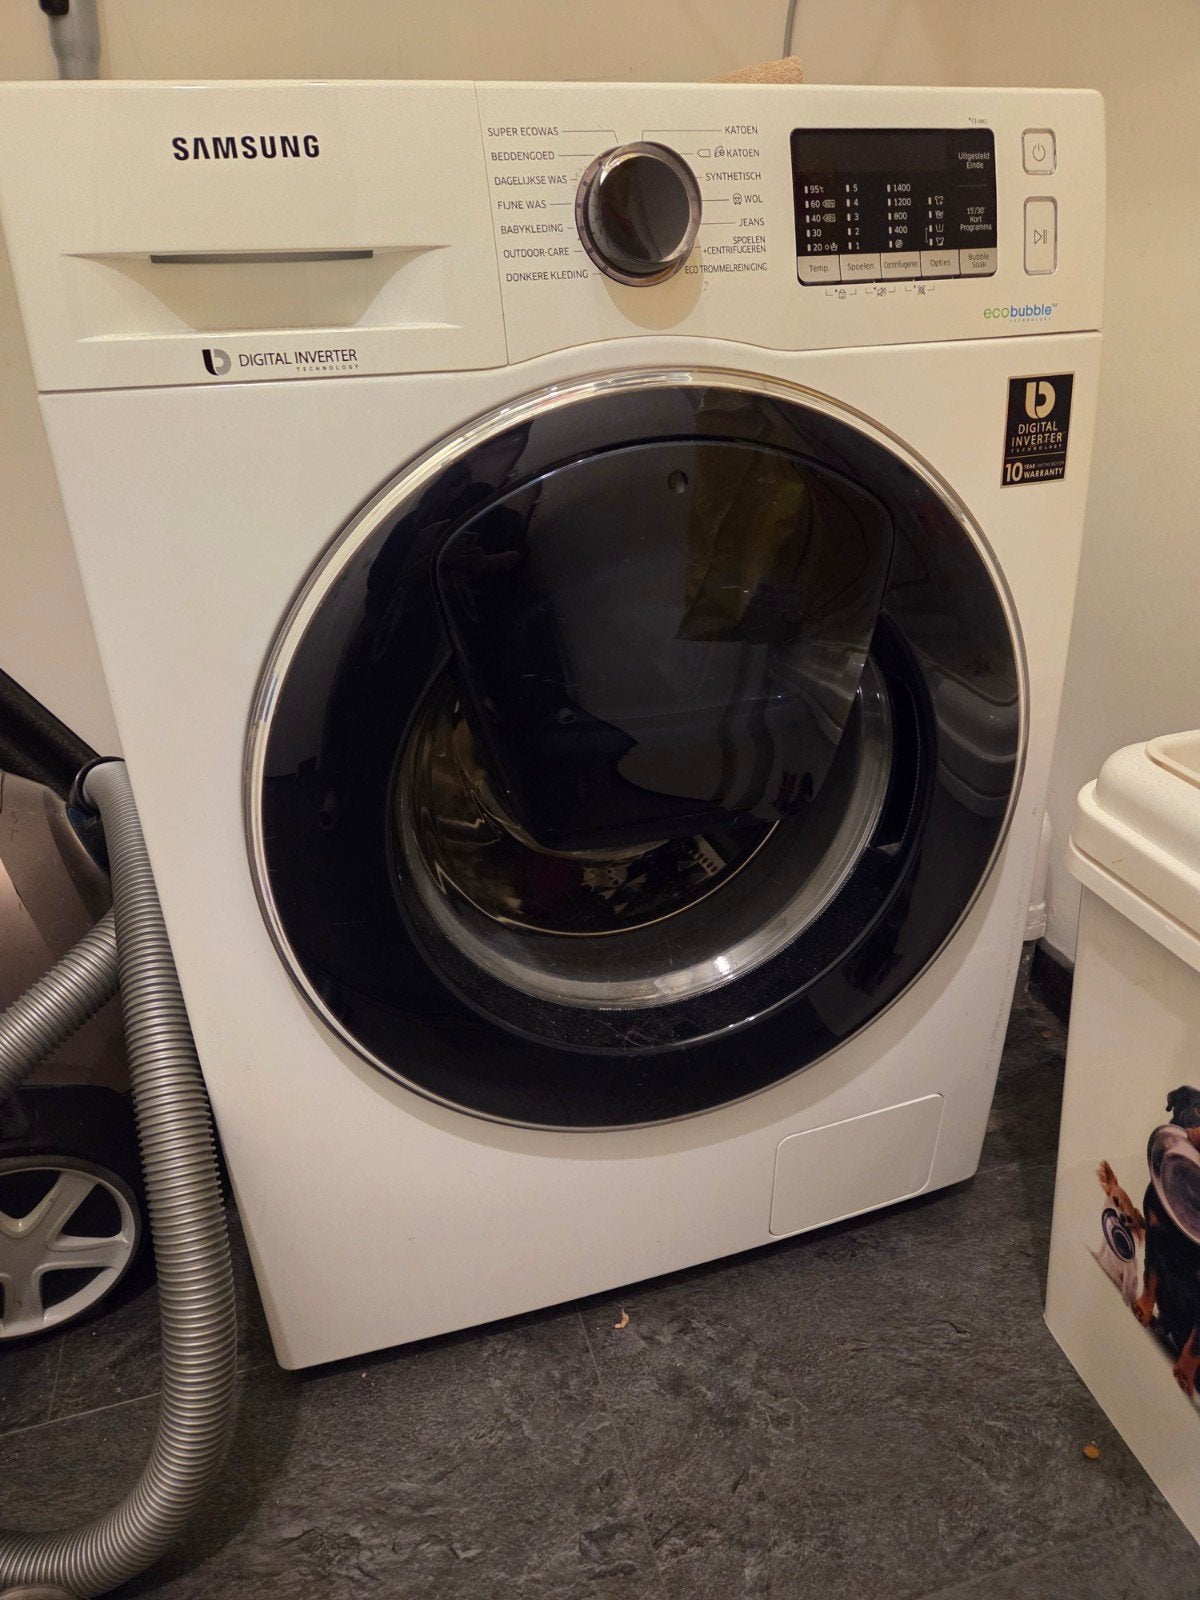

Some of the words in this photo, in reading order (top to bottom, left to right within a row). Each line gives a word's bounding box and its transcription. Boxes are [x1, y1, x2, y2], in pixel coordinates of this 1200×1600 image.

[487, 128, 518, 136] SUPER
[521, 127, 559, 136] ECOWAS
[725, 126, 758, 134] KATOEN
[172, 134, 320, 160] SAMSUNG
[491, 151, 555, 161] BEDDENGOED
[727, 148, 760, 157] KATOEN
[958, 152, 990, 161] Uitgesteld
[966, 161, 984, 169] Einde
[494, 176, 546, 186] DAGELIJKSE
[548, 175, 567, 184] WAS
[705, 172, 761, 181] SYNTHETISCH
[853, 184, 858, 192] 5
[893, 184, 911, 192] 1400
[744, 194, 763, 203] WOL
[853, 198, 859, 206] 4
[894, 198, 912, 206] 1200
[497, 200, 524, 210] FIJNE
[525, 200, 547, 209] WAS
[811, 200, 820, 208] 60
[812, 214, 821, 223] 40
[854, 212, 859, 221] 3
[894, 212, 908, 220] 800
[739, 218, 765, 227] JEANS
[500, 224, 564, 234] BABYKLEDING
[855, 228, 860, 236] 2
[894, 226, 908, 234] 400
[960, 223, 992, 232] Programma
[812, 229, 822, 237] 30
[732, 235, 766, 244] SPOELEN
[813, 243, 823, 251] 20
[503, 247, 570, 258] OUTDOOR-CARE
[968, 253, 990, 261] Bubble
[685, 265, 698, 274] ECO
[700, 262, 767, 274] TROMMELREINIGING
[847, 262, 874, 271] Spoelen
[883, 260, 919, 269] Centrifugeren
[930, 259, 951, 268] Opties
[506, 272, 548, 282] DONKERE
[550, 270, 589, 280] KLEDING
[238, 352, 292, 367] DIGITAL
[295, 349, 358, 364] INVERTER
[296, 364, 359, 372] TECHNOLOGY
[1018, 421, 1058, 434] DIGITAL
[1011, 432, 1063, 447] INVERTER
[1005, 462, 1023, 482] 10
[1024, 467, 1063, 479] WARRANTY
